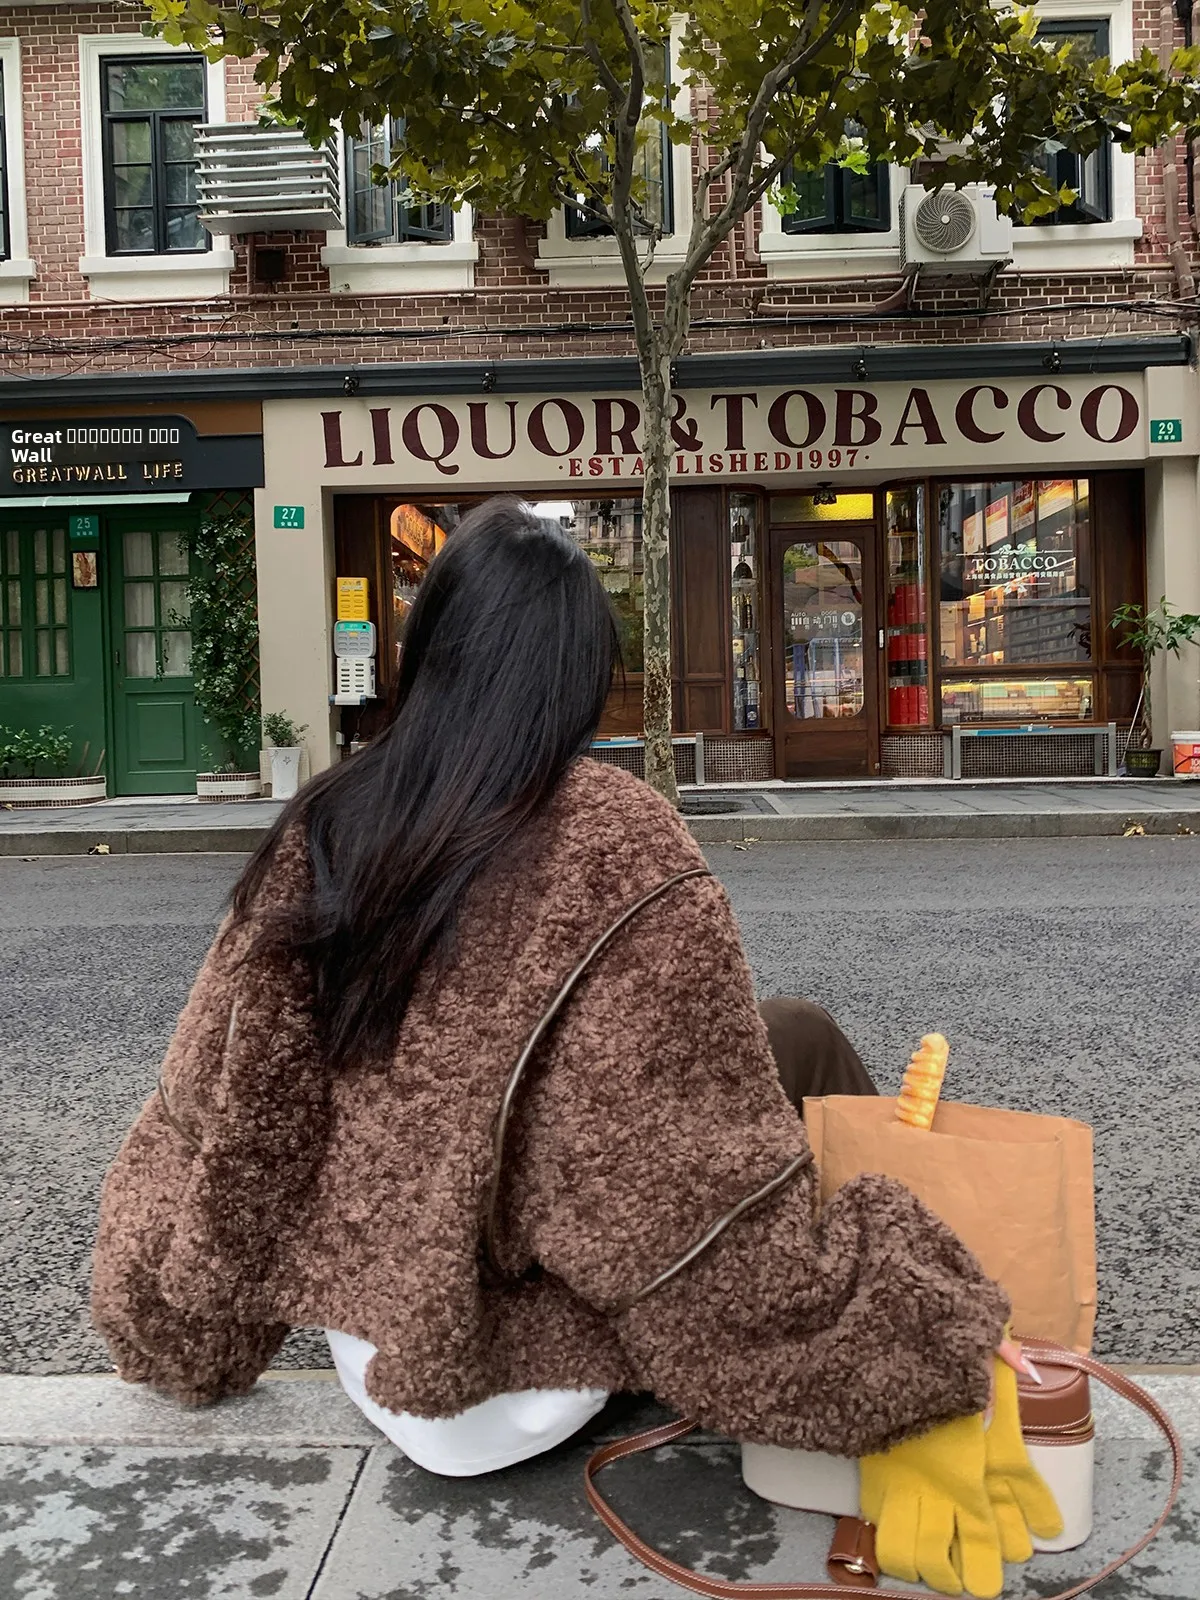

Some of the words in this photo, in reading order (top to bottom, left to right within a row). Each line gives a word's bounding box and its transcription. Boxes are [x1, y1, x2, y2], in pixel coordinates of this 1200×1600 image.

[1158, 421, 1174, 435] 29
[12, 463, 128, 483] GREATWALL
[143, 462, 183, 480] LIFE
[282, 507, 296, 520] 27
[76, 517, 91, 529] 25
[971, 555, 1058, 572] TOBACCO
